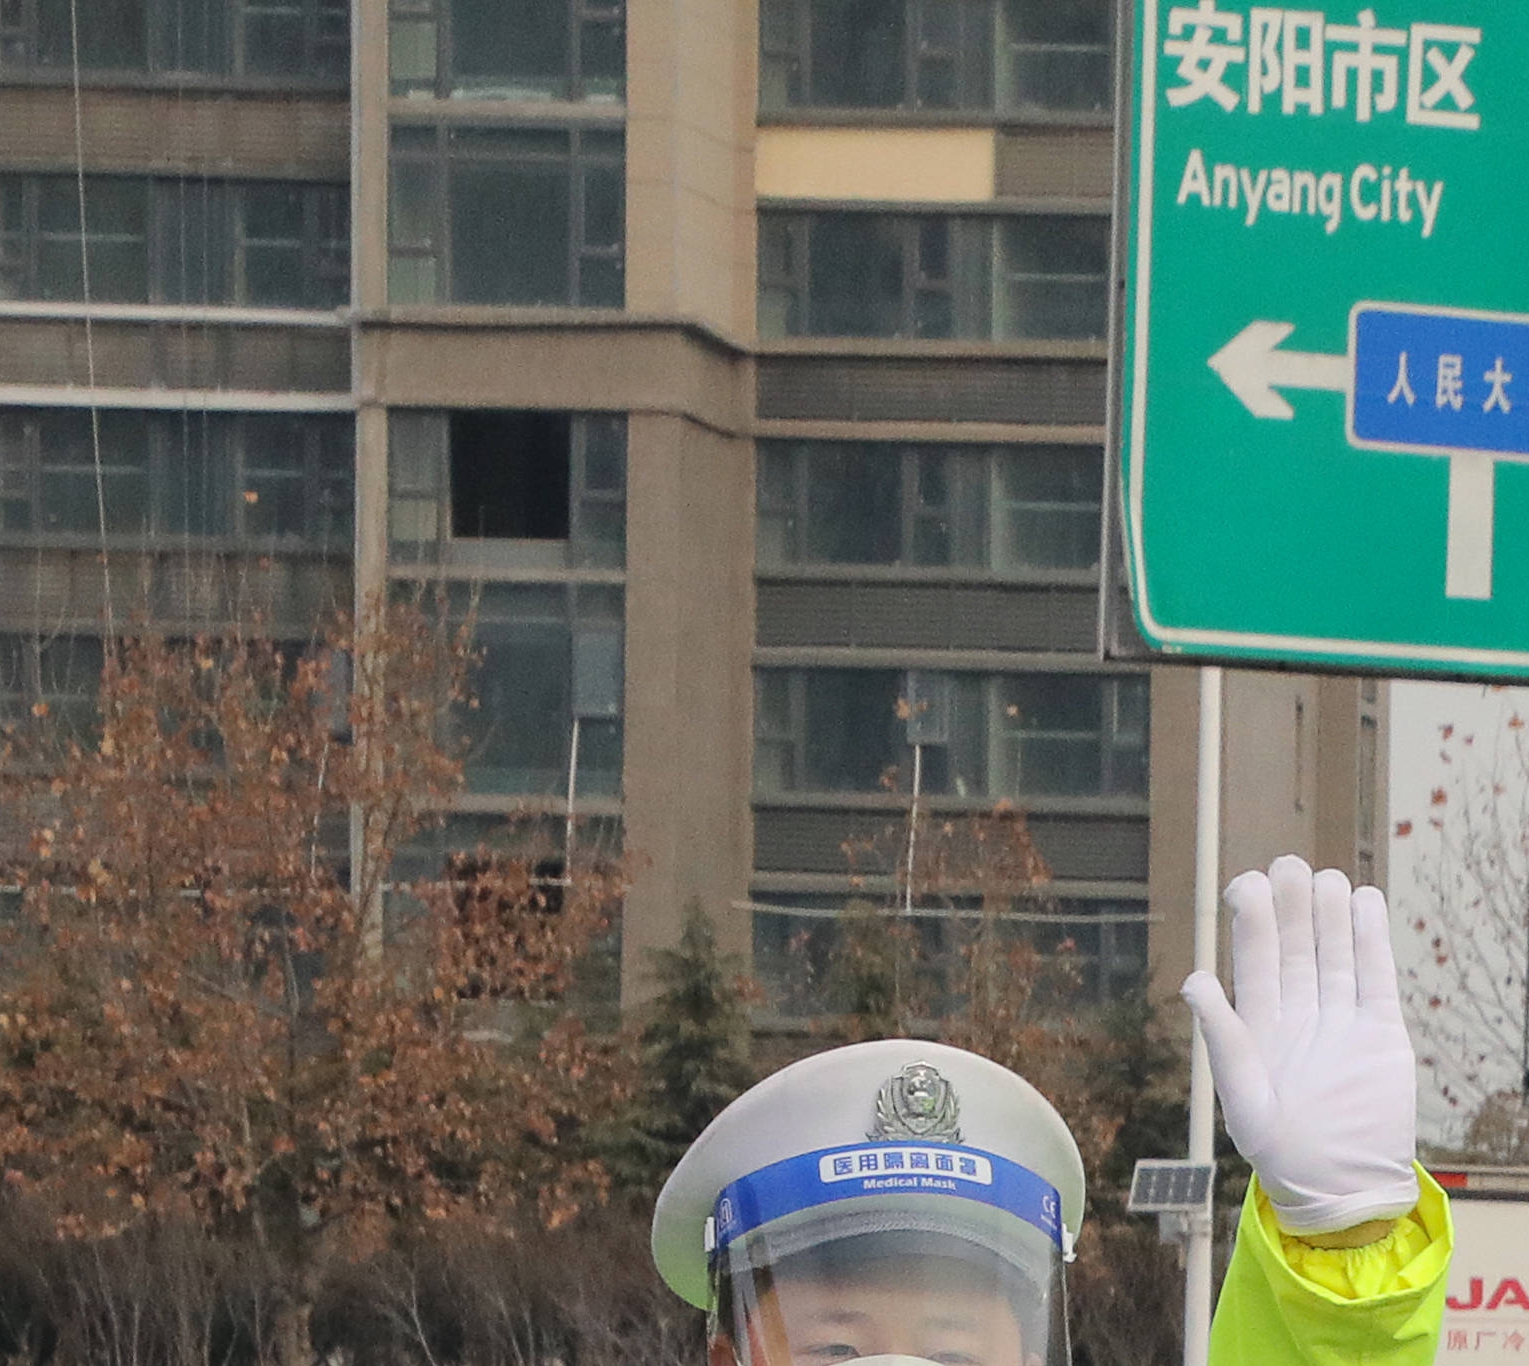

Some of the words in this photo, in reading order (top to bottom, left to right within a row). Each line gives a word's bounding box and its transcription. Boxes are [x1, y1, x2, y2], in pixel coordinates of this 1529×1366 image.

[1165, 0, 1481, 130] 安阳市区
[863, 1178, 918, 1190] Medical
[920, 1178, 957, 1191] Mask
